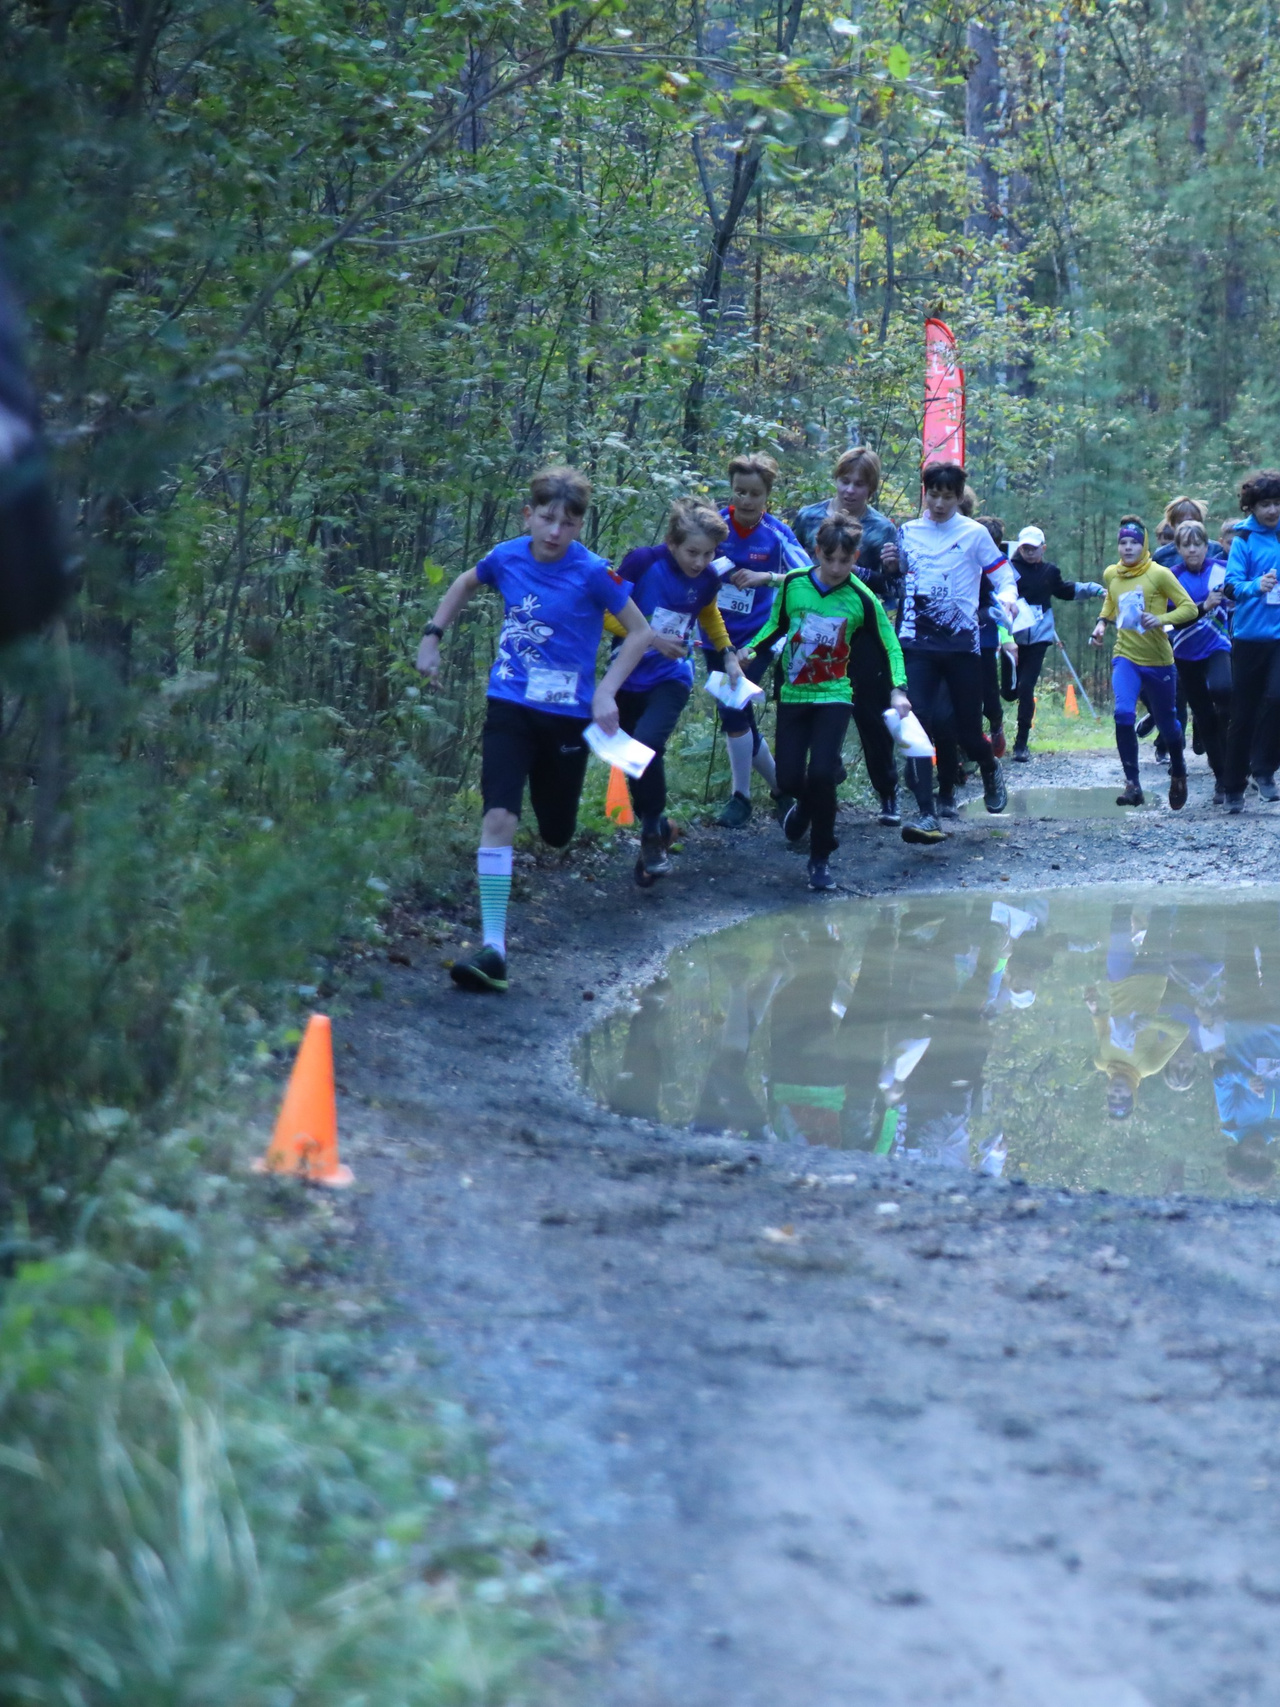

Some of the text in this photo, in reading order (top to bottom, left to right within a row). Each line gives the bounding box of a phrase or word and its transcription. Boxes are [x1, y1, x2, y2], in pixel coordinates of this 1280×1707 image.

[931, 586, 949, 599] 325
[731, 600, 750, 612] 301
[814, 633, 835, 646] 304
